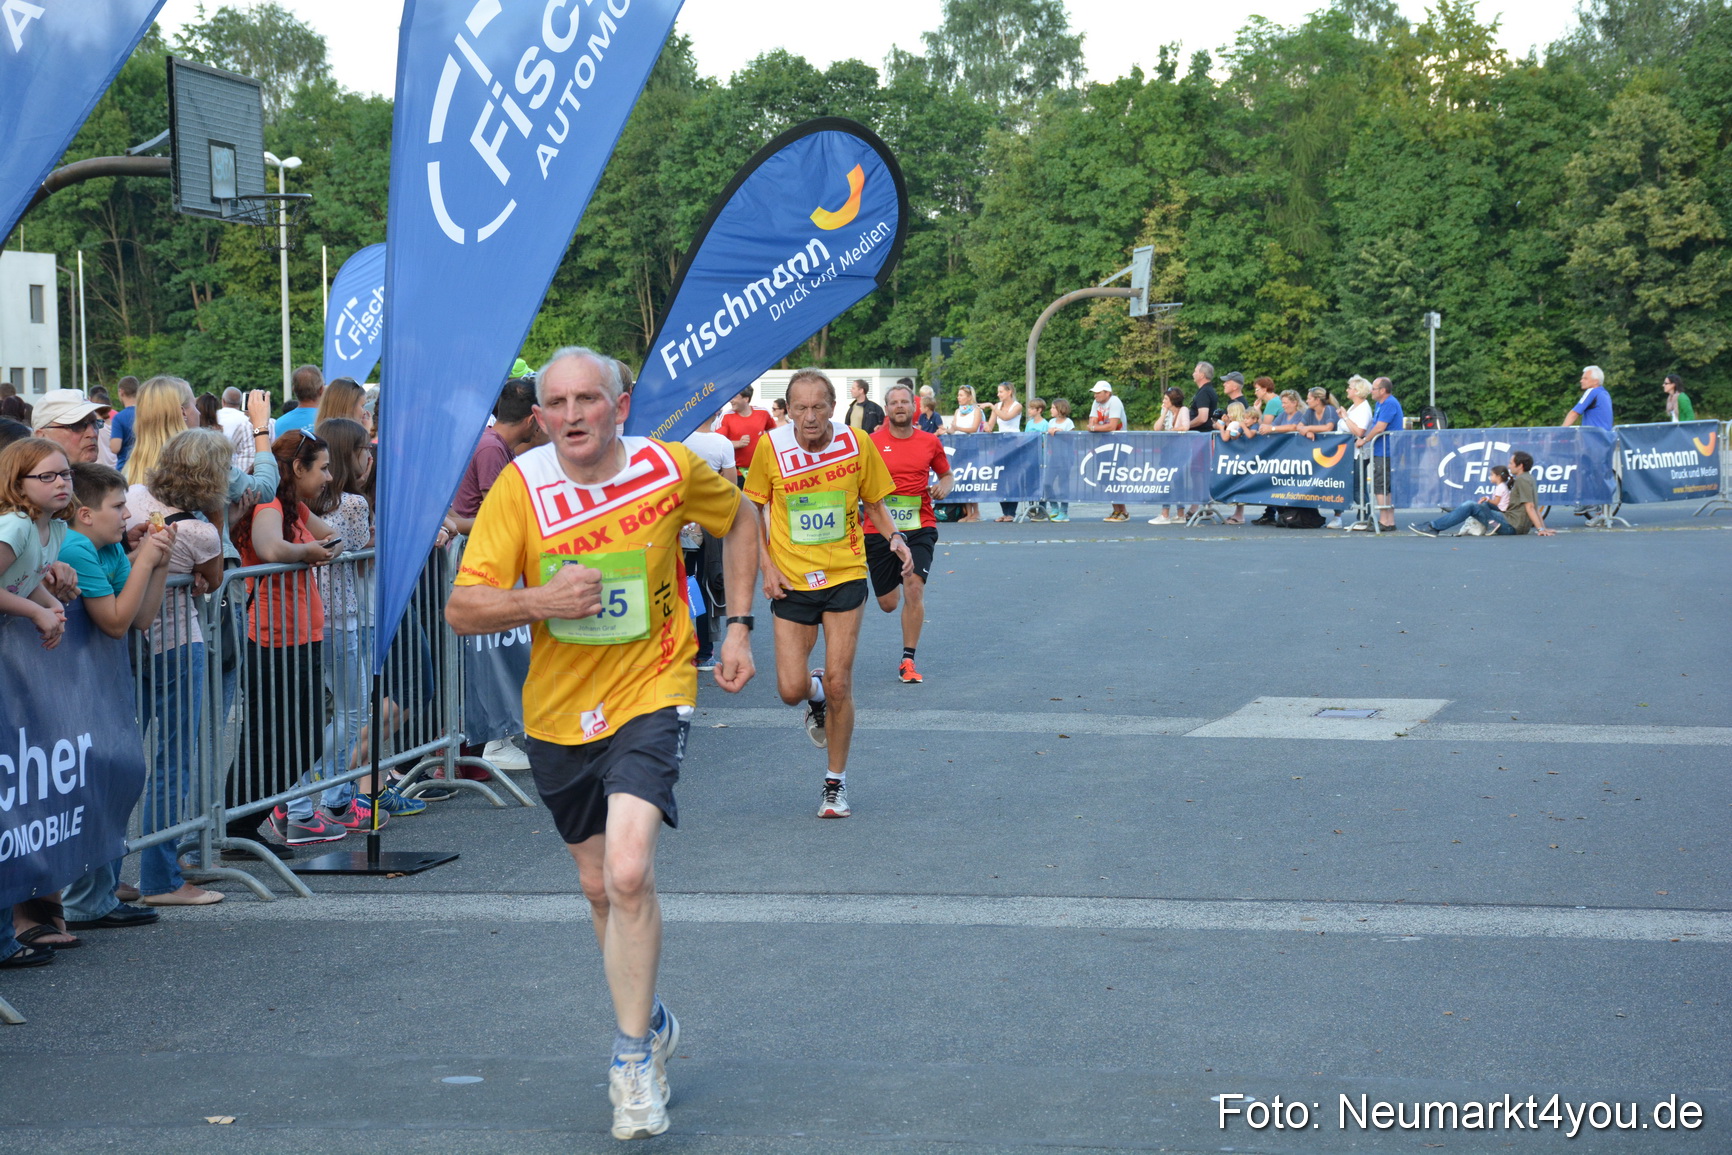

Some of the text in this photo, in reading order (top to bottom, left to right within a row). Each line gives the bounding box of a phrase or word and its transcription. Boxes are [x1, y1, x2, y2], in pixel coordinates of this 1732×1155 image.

[469, 0, 597, 187] Fisc
[768, 220, 891, 322] Druck und Medien
[660, 237, 831, 381] Frischmann
[650, 381, 717, 439] hmann-net.de
[1216, 454, 1313, 475] Frischmann
[1624, 447, 1699, 471] Frischmann
[784, 461, 862, 494] MAX BÖGL
[1096, 461, 1179, 482] Fischer
[1271, 475, 1345, 489] Druck und Medien
[1671, 468, 1689, 480] Druck
[1689, 468, 1700, 479] und
[1104, 484, 1170, 494] AUTOMOBILE
[618, 492, 685, 536] BÖGL
[799, 511, 836, 532] 904
[890, 508, 913, 521] 965
